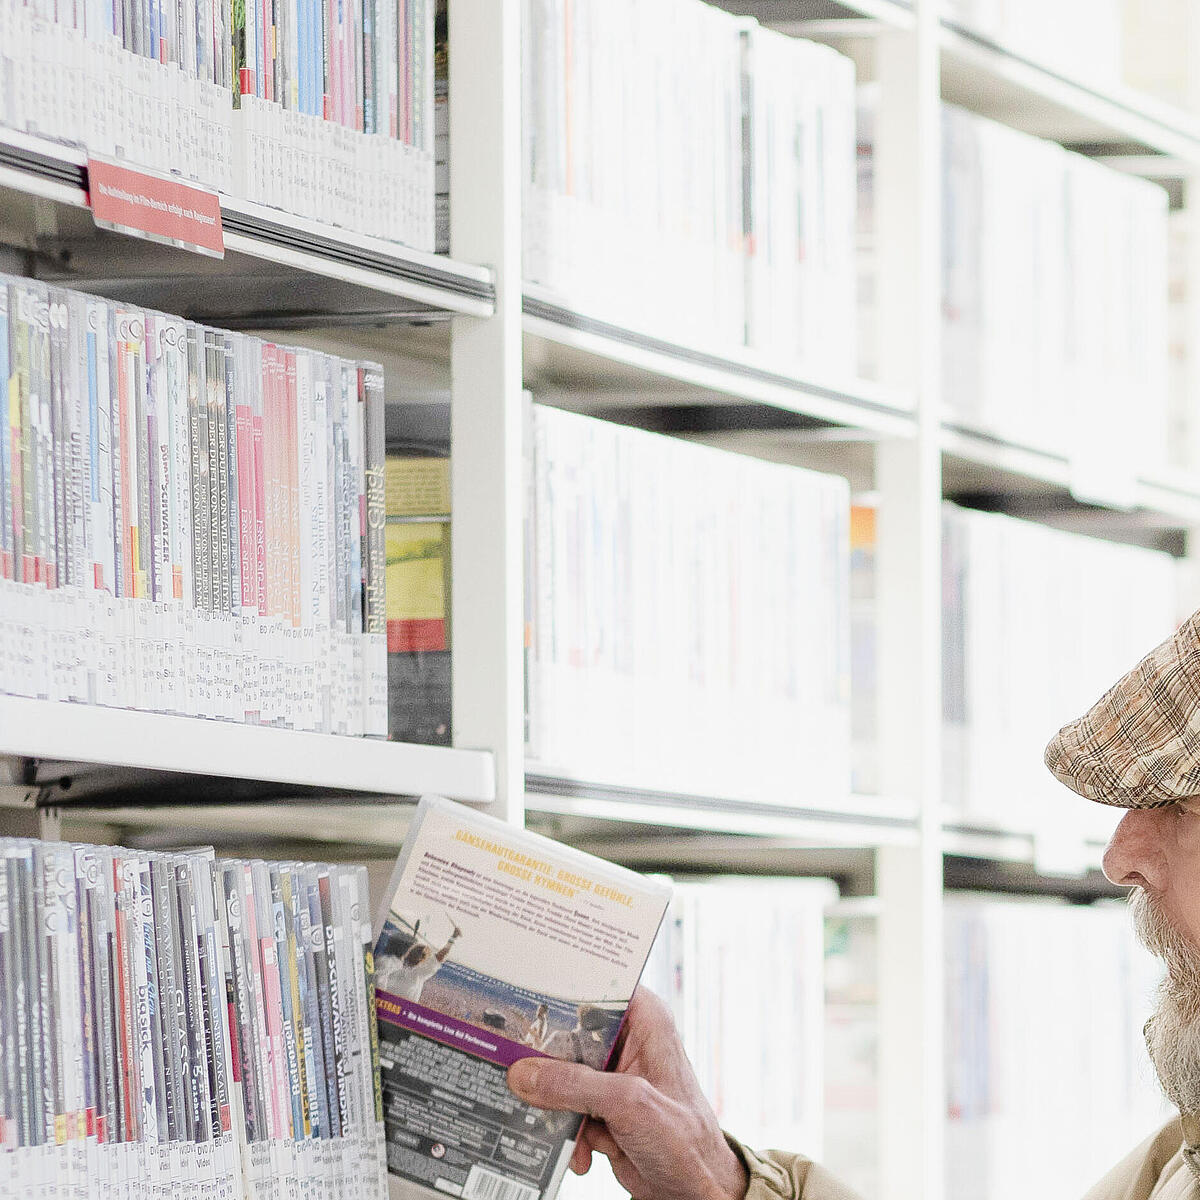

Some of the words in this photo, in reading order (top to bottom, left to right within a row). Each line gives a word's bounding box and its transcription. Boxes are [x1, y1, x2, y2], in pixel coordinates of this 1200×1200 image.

[191, 416, 199, 442] DER
[209, 421, 217, 447] DER
[193, 483, 201, 510] VON
[160, 884, 171, 927] LADY
[325, 925, 334, 958] DIE
[233, 933, 248, 1025] Eastwood
[140, 1018, 151, 1051] sick
[176, 989, 189, 1076] GLASS
[283, 1020, 299, 1096] Betrogen
[164, 1066, 175, 1128] NIGHT
